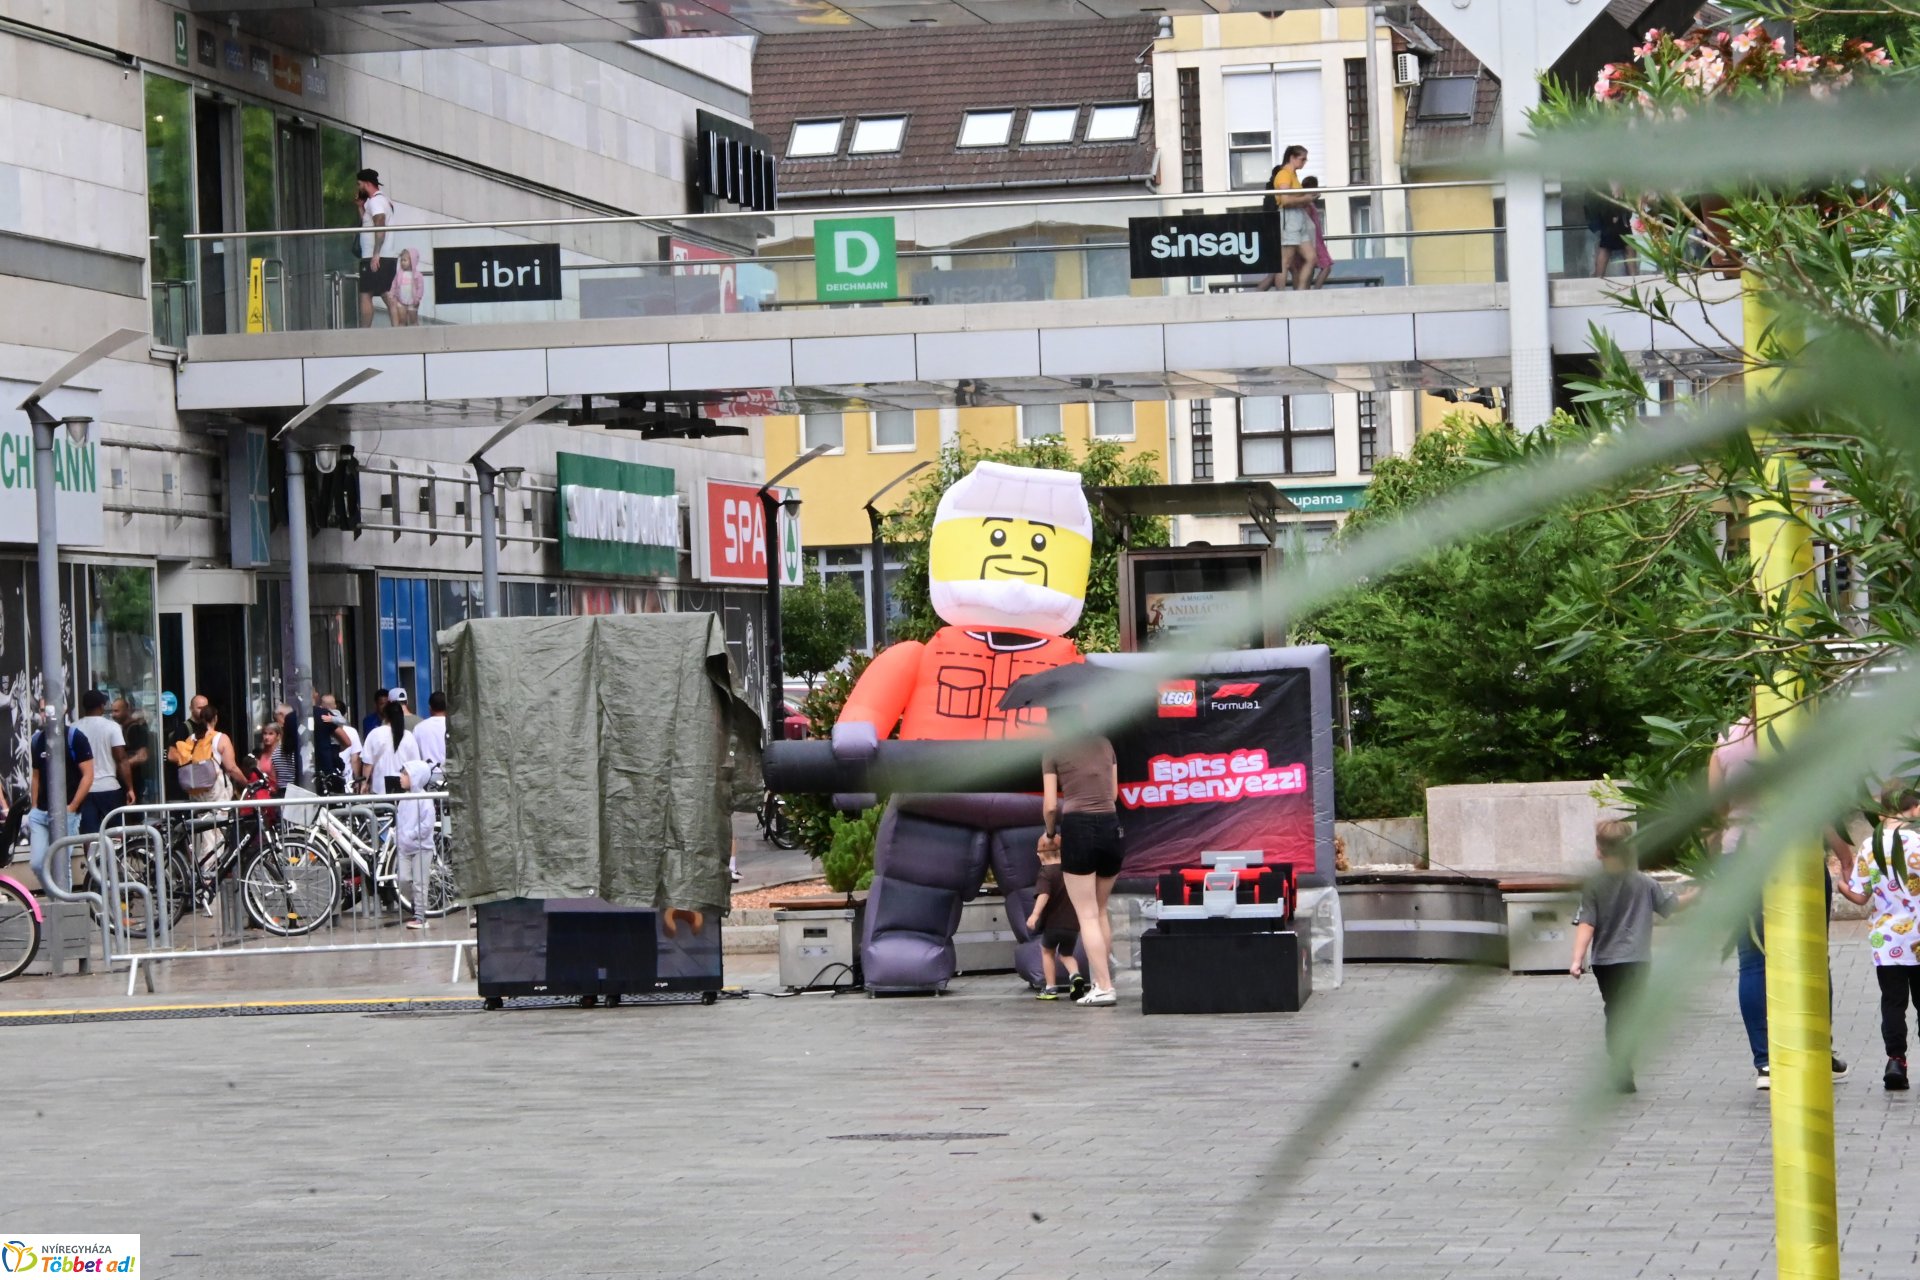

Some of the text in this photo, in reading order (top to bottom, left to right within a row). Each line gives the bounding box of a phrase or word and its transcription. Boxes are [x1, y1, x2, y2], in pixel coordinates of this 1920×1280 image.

[834, 230, 881, 277] D
[1150, 226, 1260, 265] sinsay
[454, 259, 541, 289] Libri
[826, 281, 889, 292] DEICHMANN
[0, 431, 97, 494] CHANN
[723, 499, 781, 565] SPA
[1160, 690, 1195, 706] LEGO
[1230, 753, 1264, 774] és
[1121, 769, 1302, 806] versenyezz!
